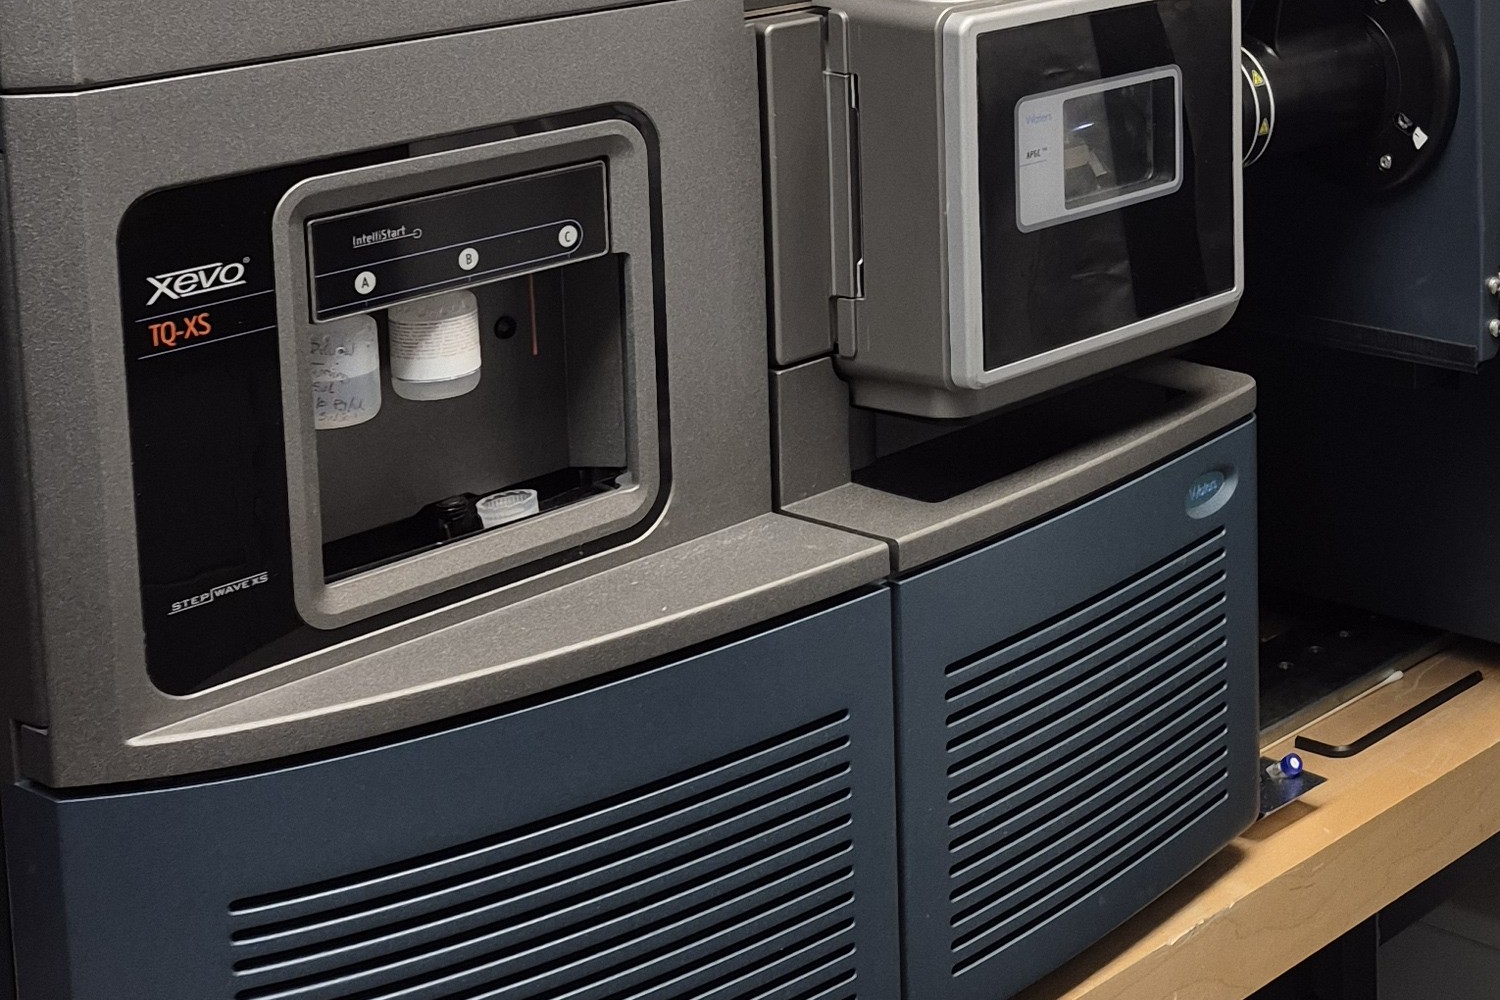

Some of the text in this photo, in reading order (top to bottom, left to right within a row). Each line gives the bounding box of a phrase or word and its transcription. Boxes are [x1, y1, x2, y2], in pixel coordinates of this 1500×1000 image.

[353, 225, 406, 246] IntelliStart
[465, 253, 473, 265] B
[360, 276, 370, 289] A
[148, 312, 212, 347] TQ-XS
